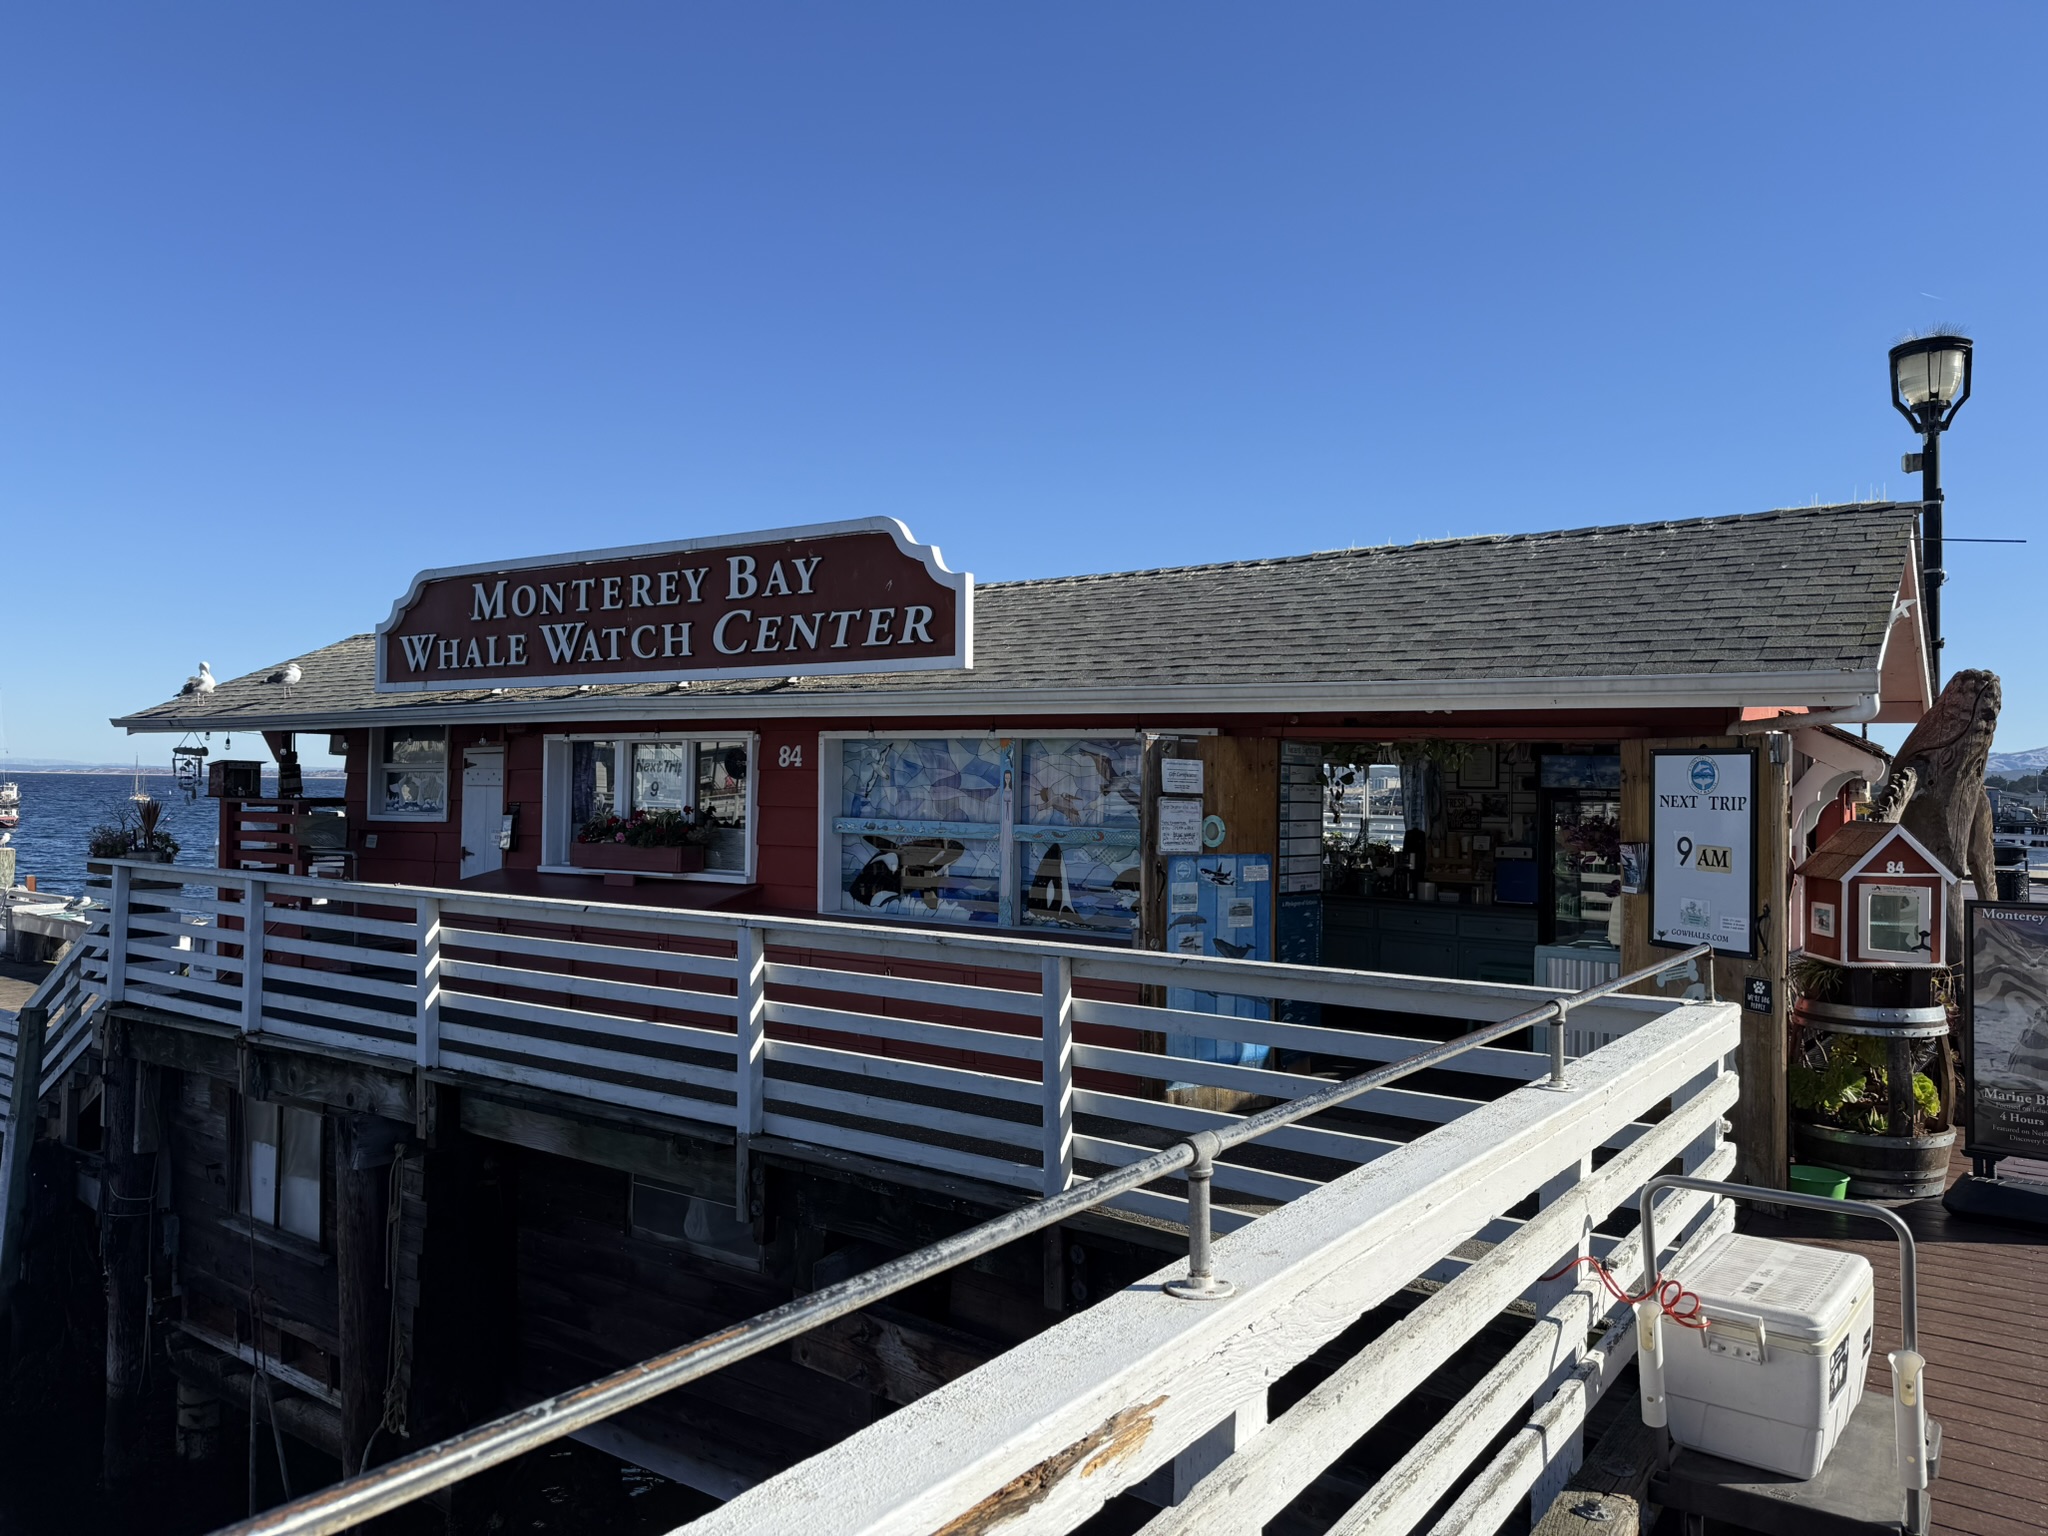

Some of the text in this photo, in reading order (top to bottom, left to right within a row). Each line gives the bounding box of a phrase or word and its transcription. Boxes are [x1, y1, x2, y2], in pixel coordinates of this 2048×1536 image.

[471, 555, 823, 622] MONTEREY BAY
[400, 605, 935, 673] WHALE WATCH CENTER
[778, 745, 802, 768] 84
[636, 759, 663, 773] Next
[650, 781, 659, 797] 9
[1659, 795, 1747, 811] NEXT TRIP
[1677, 836, 1729, 868] 9 AM
[1886, 861, 1905, 875] 84
[1982, 908, 2047, 926] Monterey
[1671, 928, 1729, 943] GOWHALES.COM
[1984, 1087, 2032, 1104] Marine
[2000, 1111, 2045, 1126] 4 Hours
[1993, 1124, 2020, 1134] Featured
[2009, 1134, 2041, 1145] Discovery
